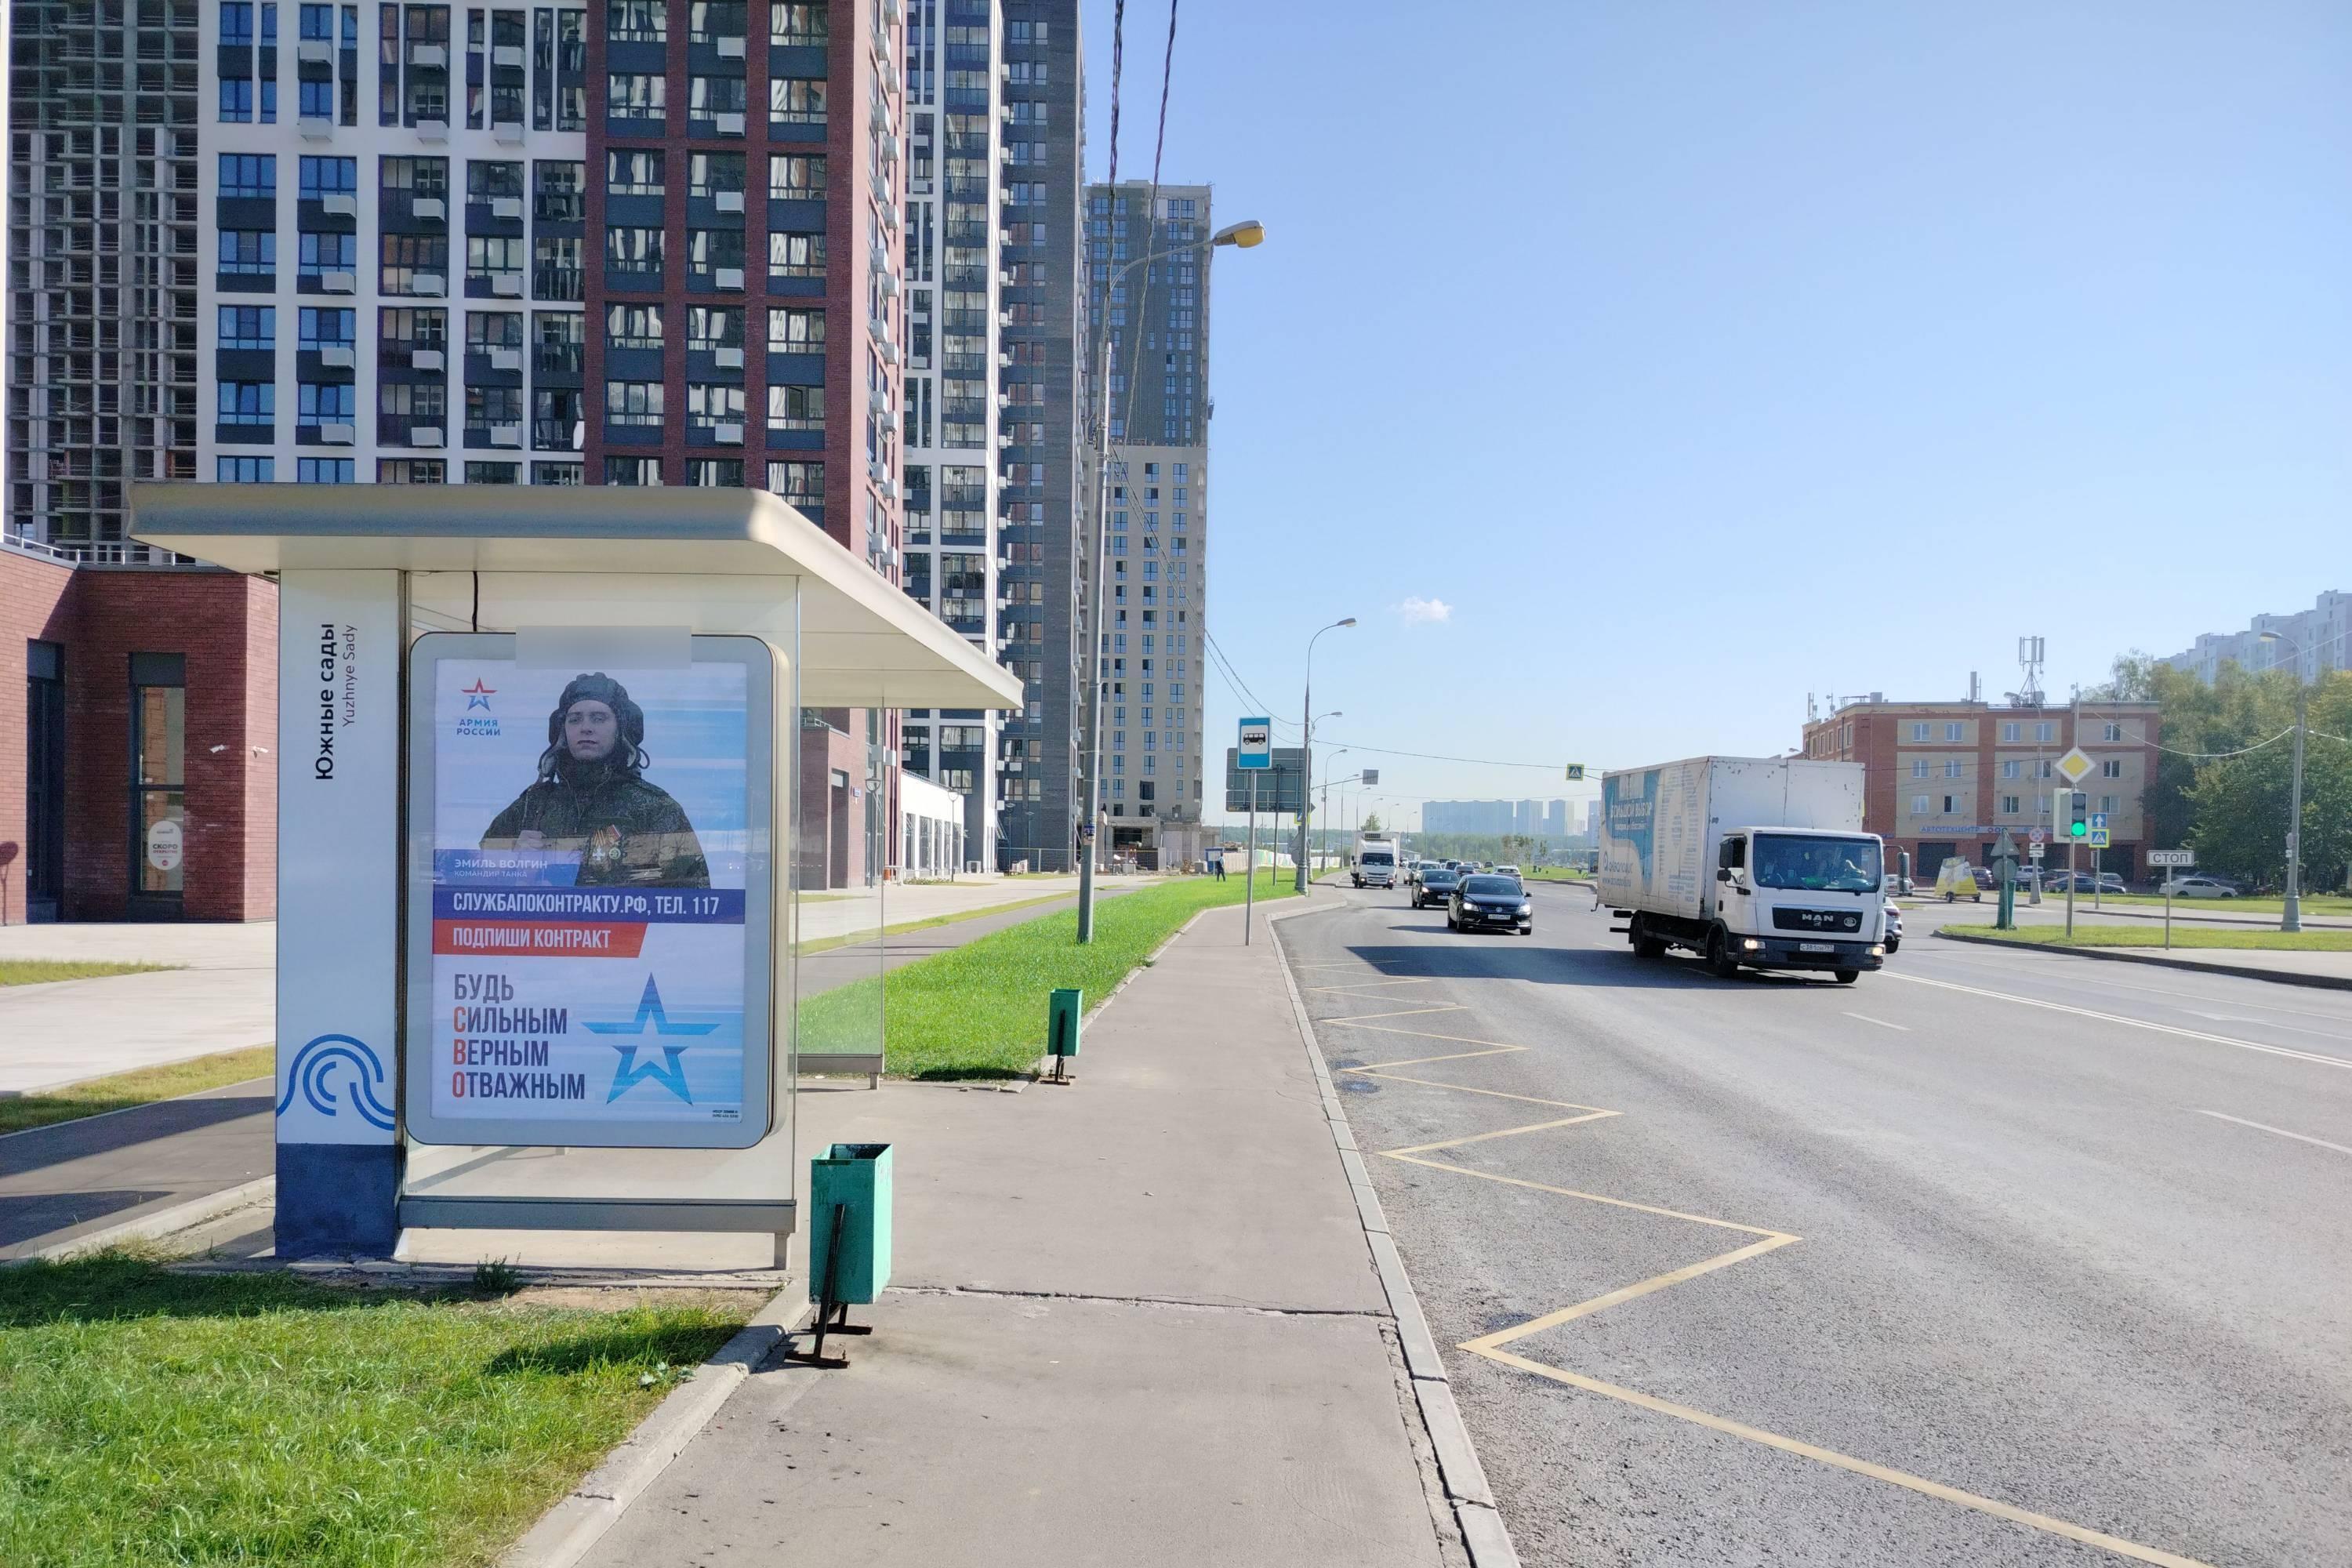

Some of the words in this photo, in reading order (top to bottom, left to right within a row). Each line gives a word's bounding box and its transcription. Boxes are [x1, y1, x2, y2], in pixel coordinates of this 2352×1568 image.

[320, 623, 337, 682] сады
[342, 624, 358, 661] Sady
[342, 665, 358, 728] Yuzhnye
[315, 688, 335, 780] Южные
[456, 728, 501, 736] РОССИИ
[459, 718, 499, 727] АРМИЯ
[454, 858, 496, 869] ЭМИЛЬ
[499, 859, 548, 869] ВОЛГИН
[2153, 853, 2189, 863] СТОП
[453, 892, 652, 916] СЛУЖБАПОКОНТРАКТУ.РФ,
[655, 895, 687, 915] ТЕЛ.
[692, 896, 720, 916] 117
[1802, 913, 1834, 922] MAN
[453, 927, 531, 949] ПОДПИШИ
[534, 929, 612, 949] КОНТРАКТ
[454, 973, 514, 1004] БУДЬ
[453, 1005, 568, 1035] СИЛЬНЫМ
[452, 1038, 549, 1067] ВЕРНЫМ
[452, 1071, 585, 1100] ОТВАЖНЫМ
